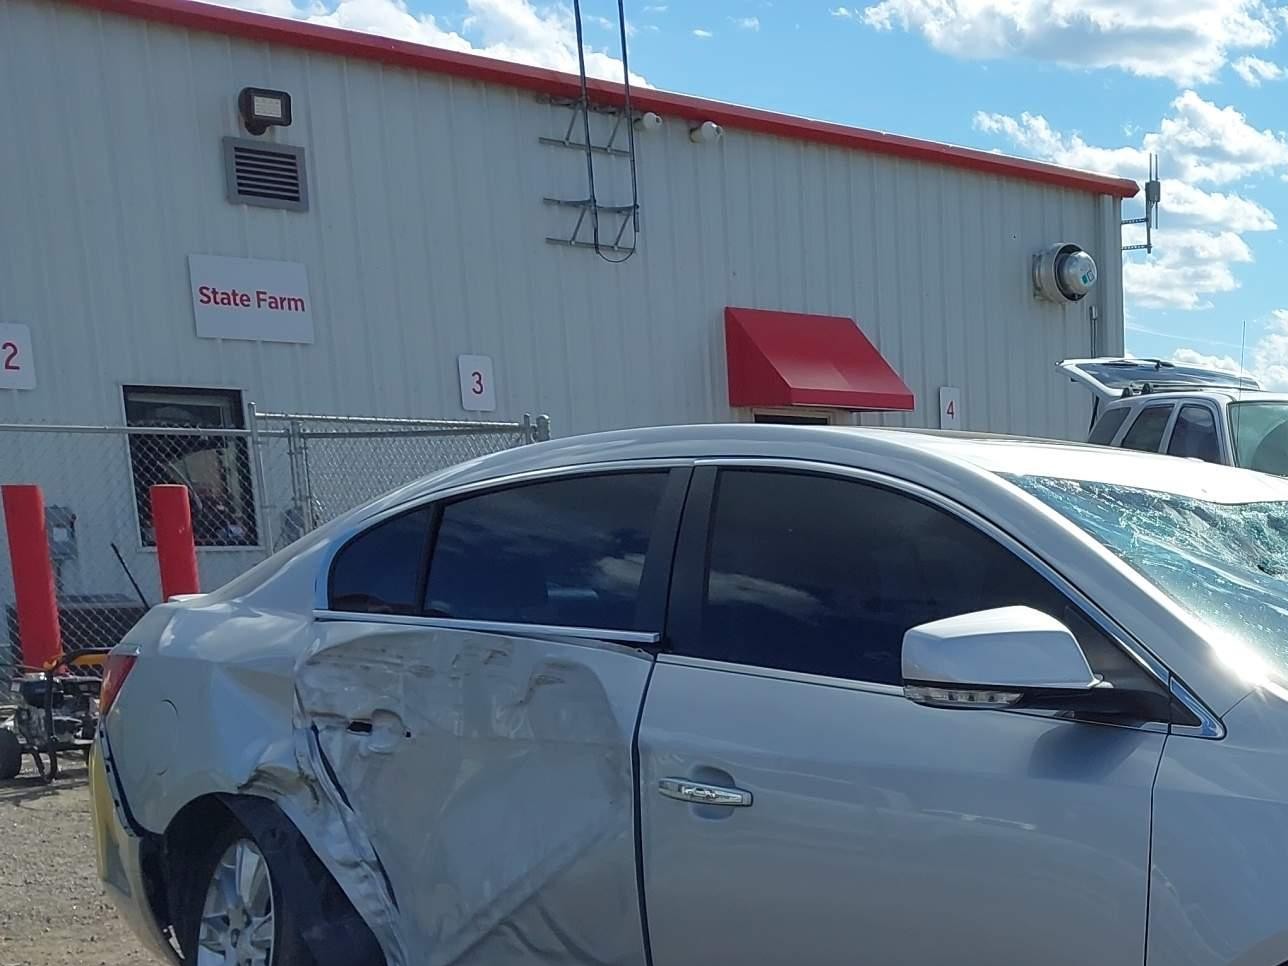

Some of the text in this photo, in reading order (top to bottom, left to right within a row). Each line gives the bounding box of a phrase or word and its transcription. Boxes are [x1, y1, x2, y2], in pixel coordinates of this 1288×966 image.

[198, 286, 306, 312] State Farm
[2, 342, 20, 370] 2
[471, 371, 484, 395] 3
[946, 400, 954, 420] 4
